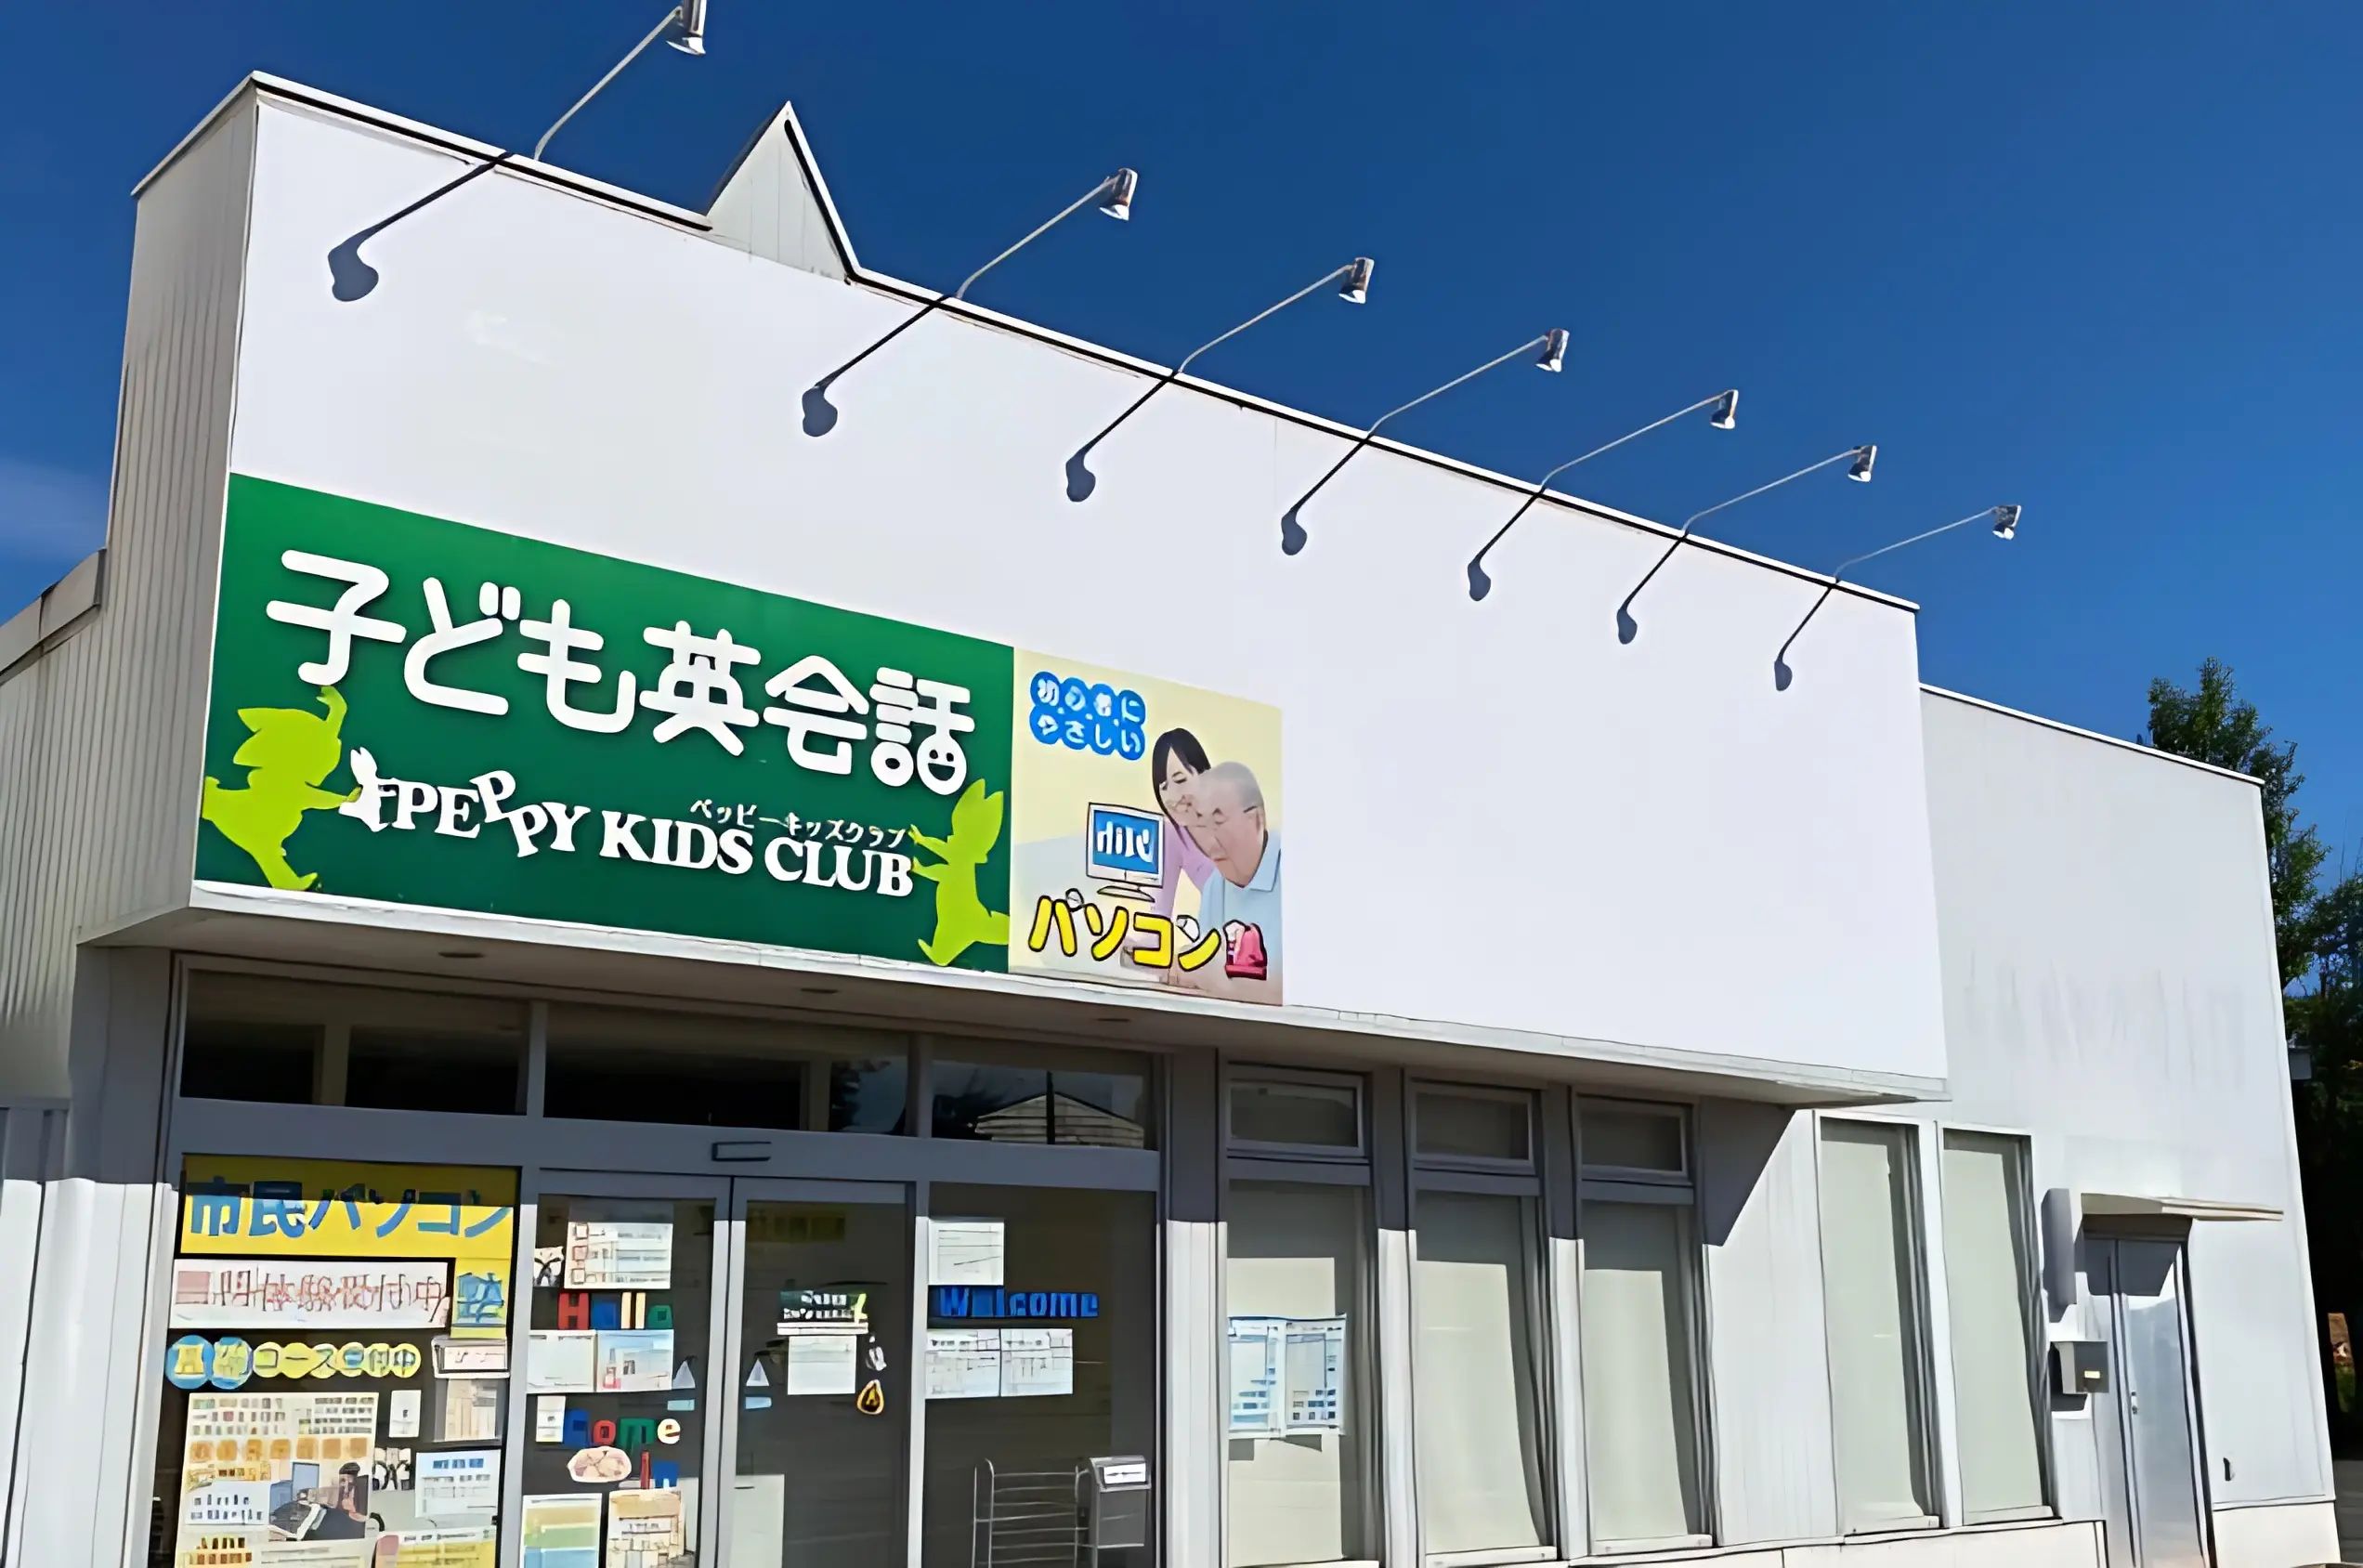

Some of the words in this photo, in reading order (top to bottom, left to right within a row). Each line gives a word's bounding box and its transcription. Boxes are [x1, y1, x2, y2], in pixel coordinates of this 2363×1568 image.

[266, 549, 975, 795] 子ども英会話
[391, 770, 592, 858] PEPPY
[599, 810, 754, 875] KIDS
[764, 836, 914, 897] CLUB
[1027, 888, 1268, 981] パソコン
